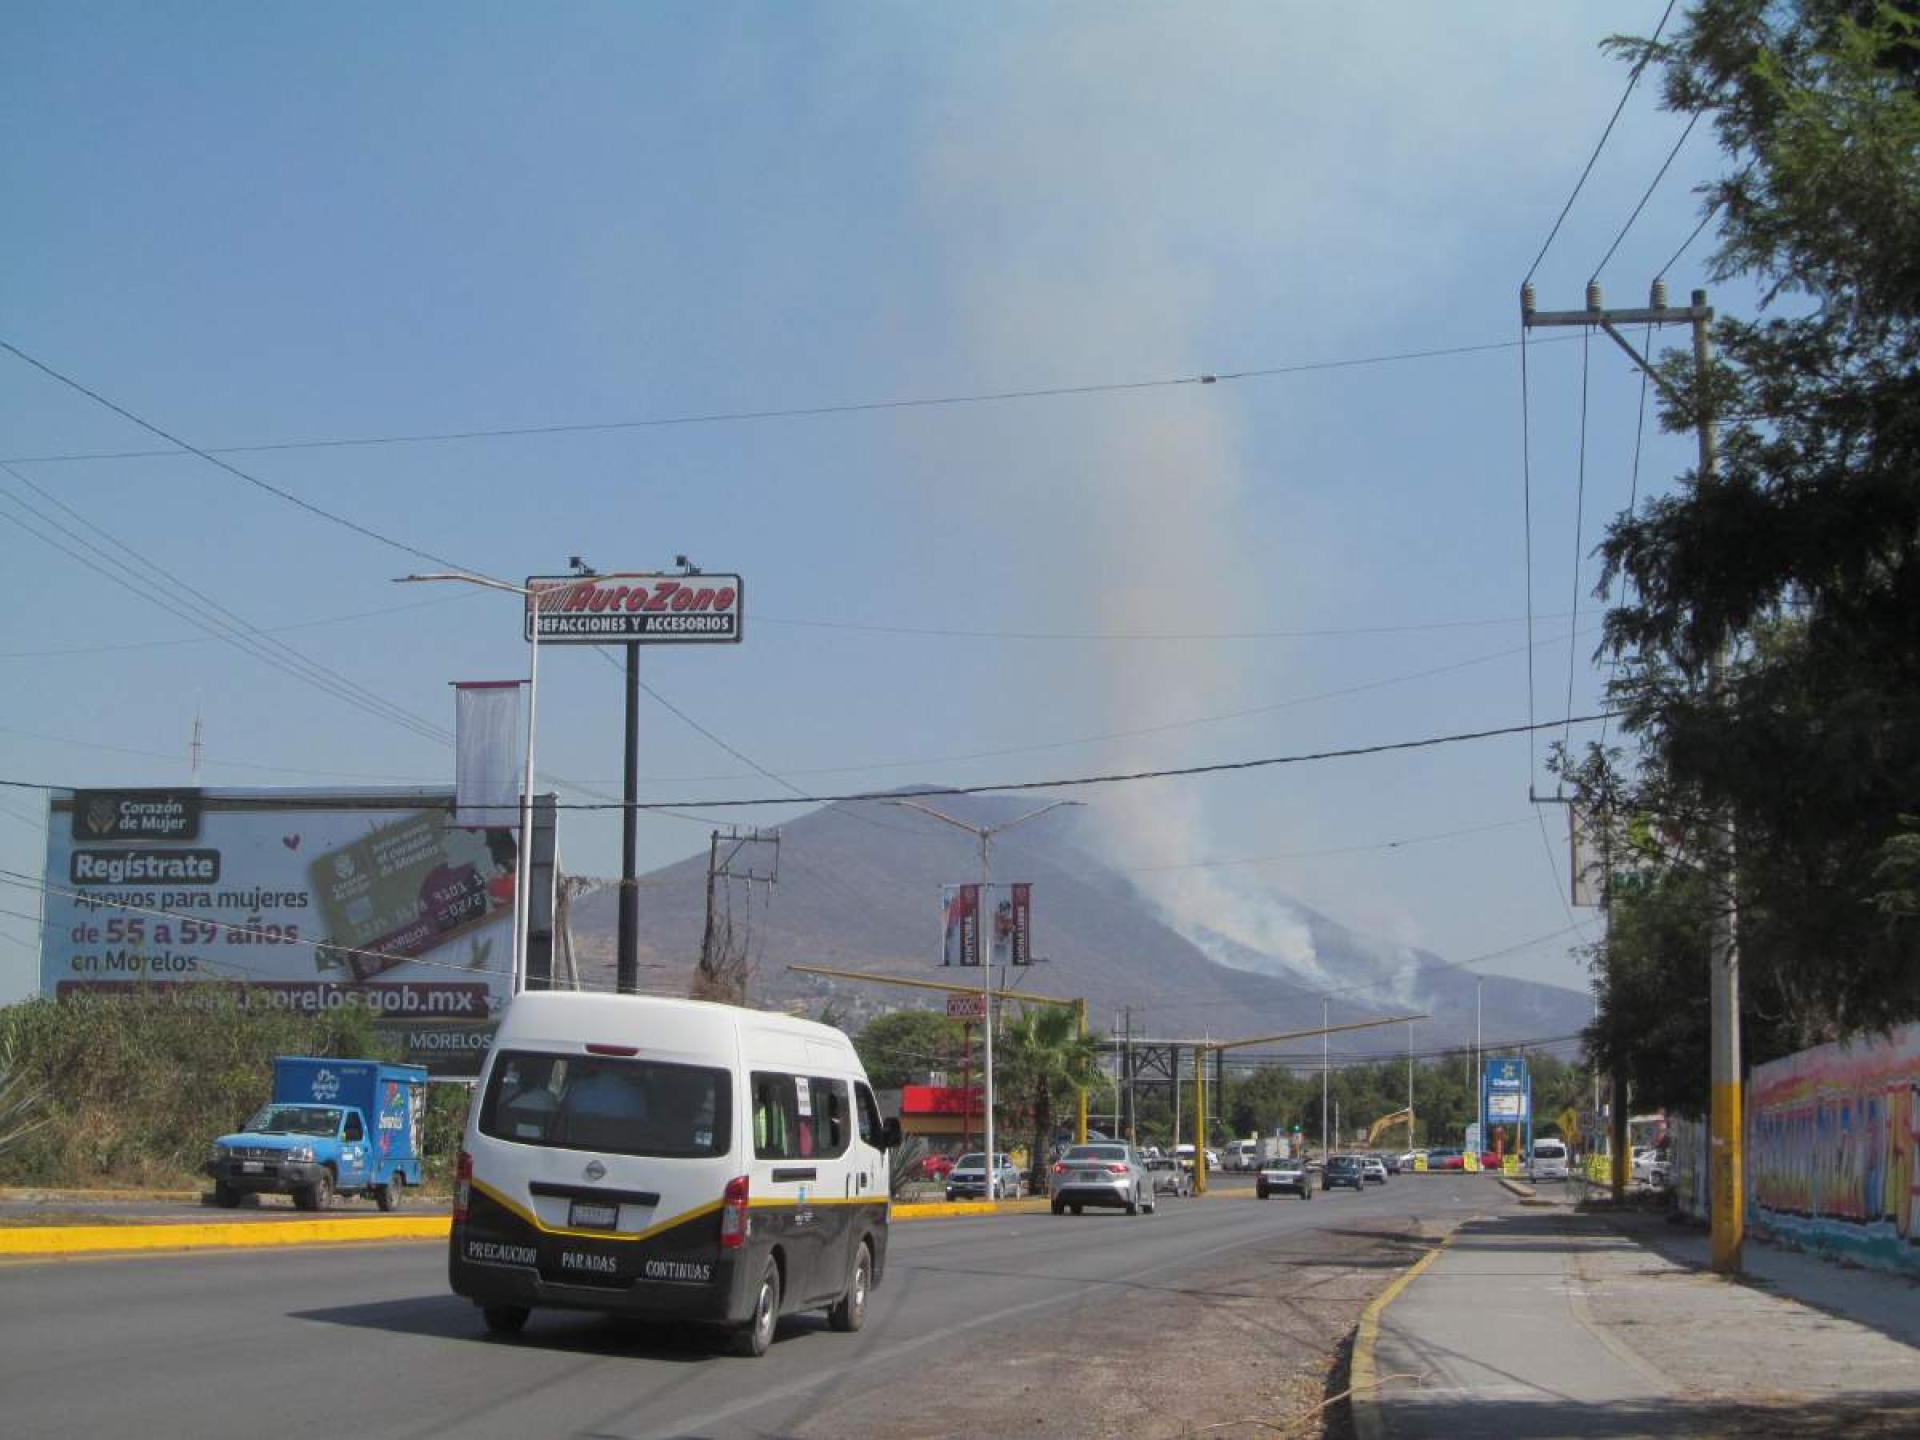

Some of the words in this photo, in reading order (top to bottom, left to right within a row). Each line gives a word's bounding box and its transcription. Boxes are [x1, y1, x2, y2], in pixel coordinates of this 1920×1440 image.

[561, 581, 735, 612] AutoZone
[537, 616, 626, 632] REFACCIONES
[631, 617, 641, 631] Y
[646, 616, 729, 631] ACCESORIOS
[119, 799, 183, 815] Corazón
[119, 816, 139, 830] de
[141, 816, 187, 833] Mujer
[76, 853, 214, 882] Regístrate
[73, 888, 157, 913] Apoyos
[161, 892, 213, 912] para
[217, 886, 309, 913] mujeres
[71, 922, 98, 944] de
[106, 918, 145, 945] 55
[153, 925, 171, 944] a
[179, 919, 218, 945] 59
[226, 916, 299, 944] años
[71, 955, 99, 973] en
[105, 951, 199, 973] Morelos
[410, 1032, 494, 1050] MORELOS
[469, 1241, 538, 1265] PRECAUCION
[562, 1252, 617, 1273] PARADAS
[646, 1260, 711, 1281] CONTINUAS
